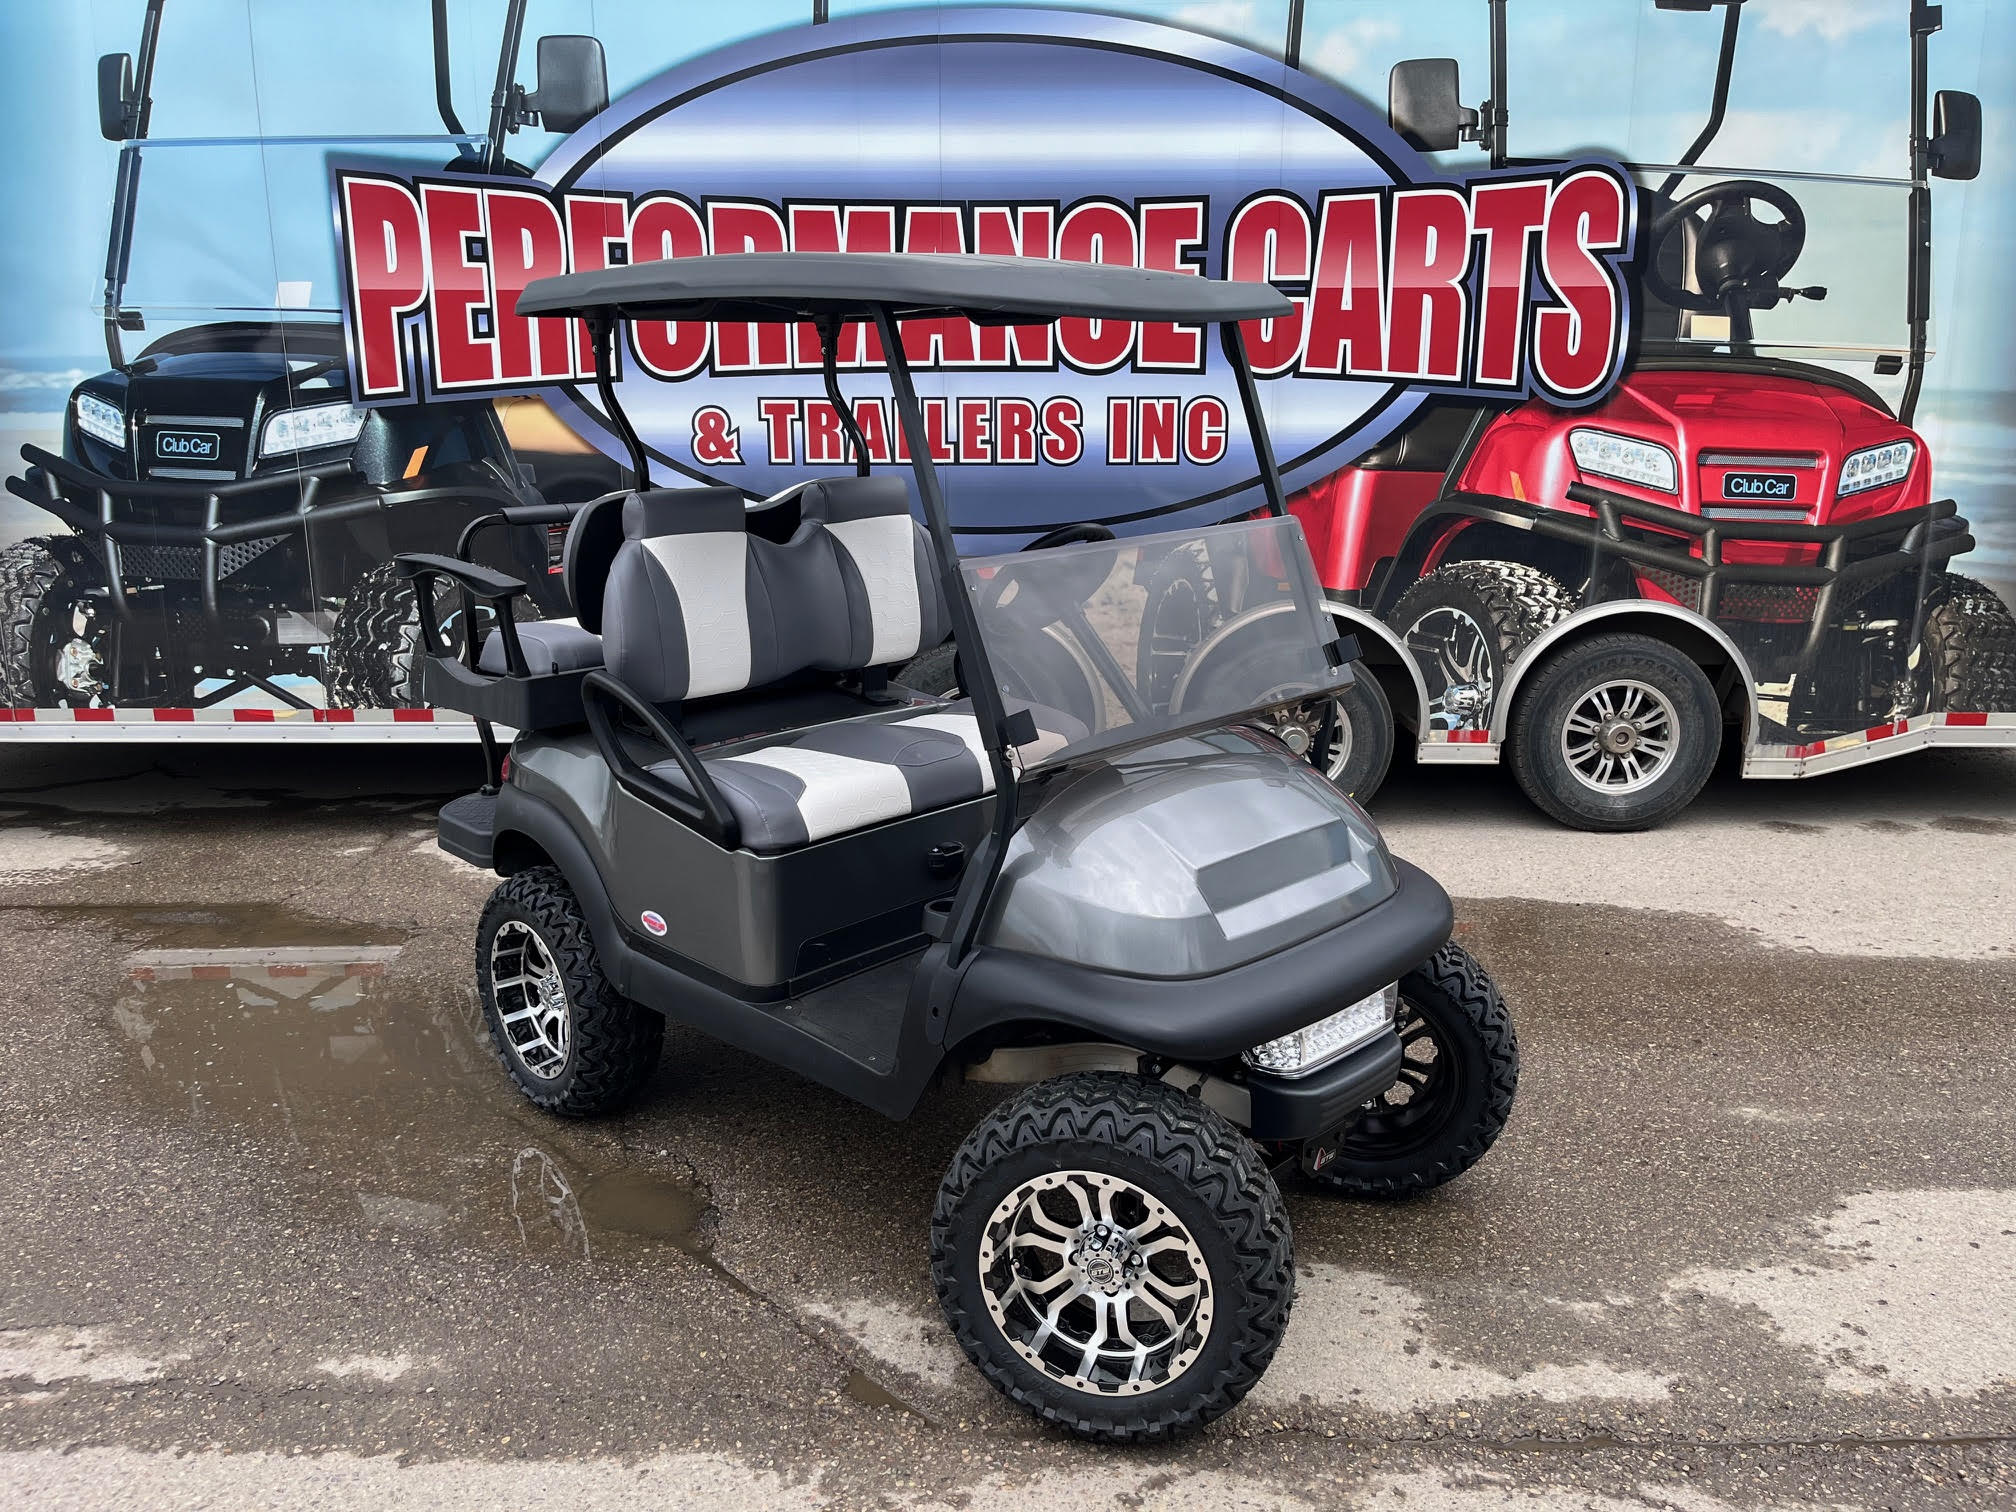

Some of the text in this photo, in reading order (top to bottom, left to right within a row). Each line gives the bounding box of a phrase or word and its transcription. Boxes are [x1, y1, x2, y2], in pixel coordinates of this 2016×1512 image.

[1226, 169, 1626, 396] CARTS
[162, 437, 212, 454] Club Car
[692, 406, 744, 465] &
[1107, 396, 1229, 465] INC
[1730, 477, 1790, 495] Club Car
